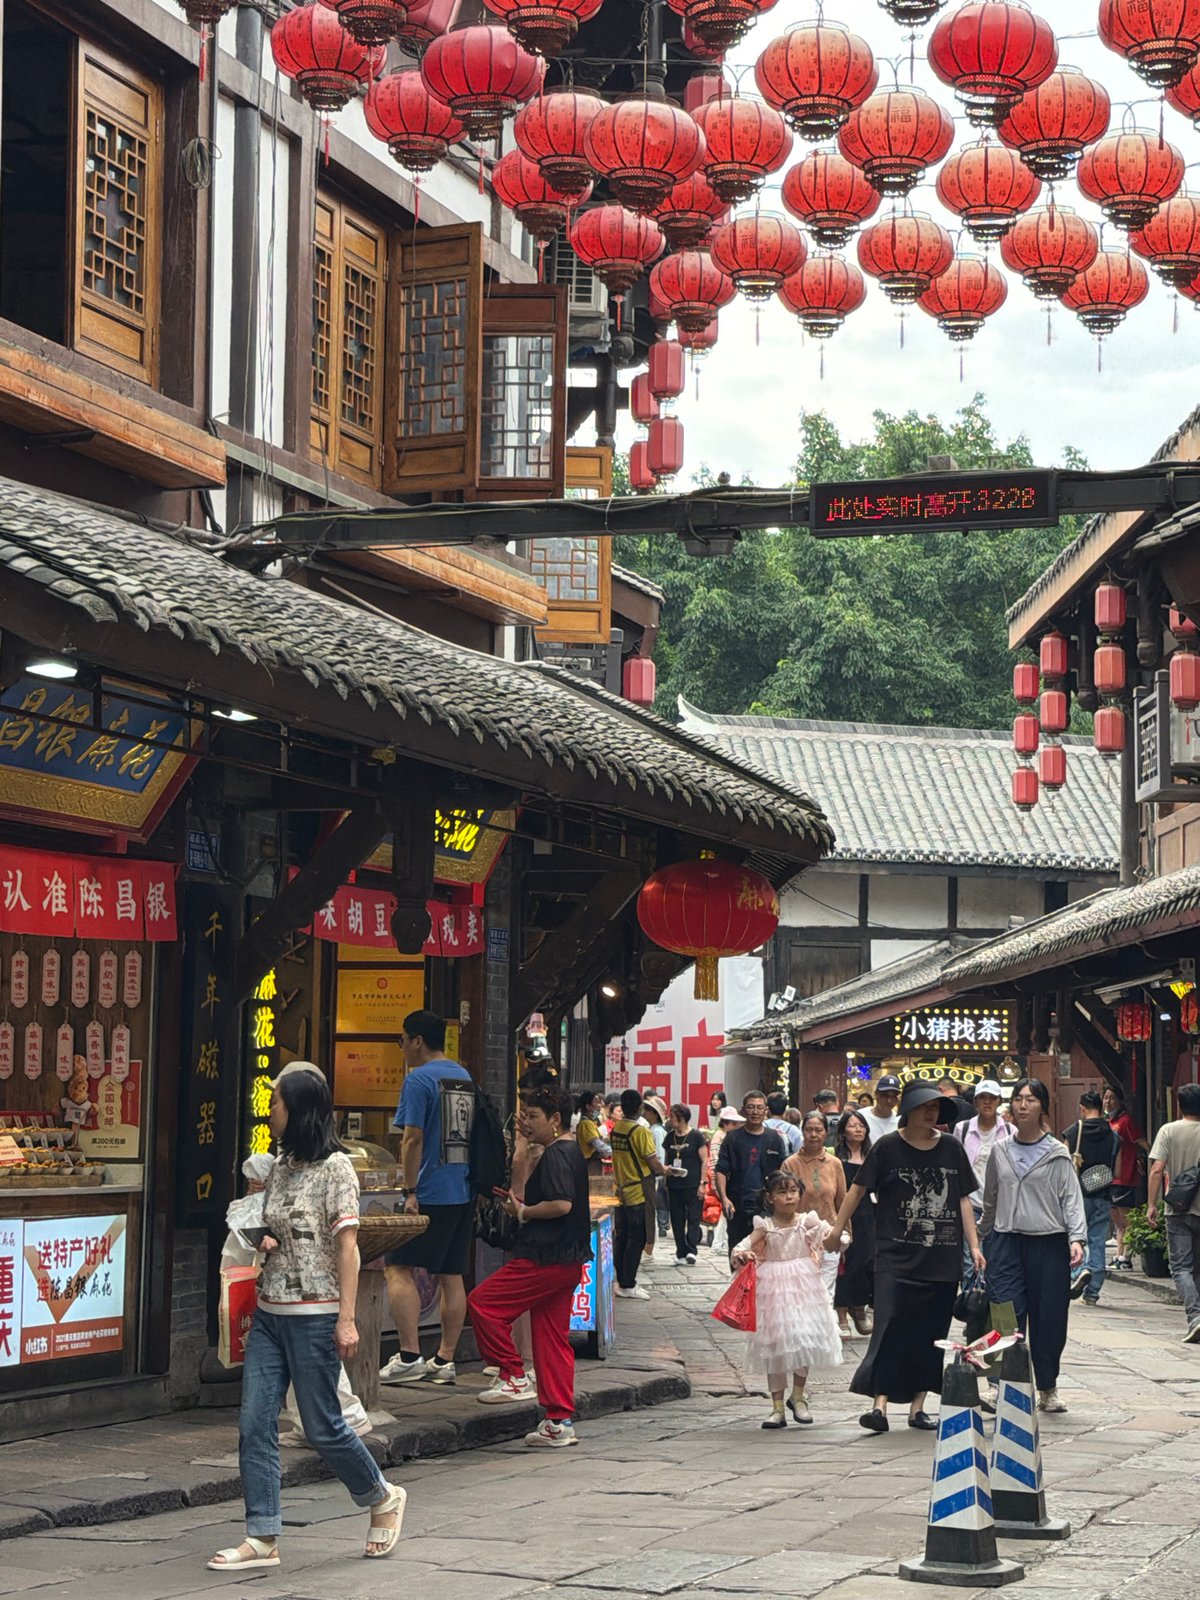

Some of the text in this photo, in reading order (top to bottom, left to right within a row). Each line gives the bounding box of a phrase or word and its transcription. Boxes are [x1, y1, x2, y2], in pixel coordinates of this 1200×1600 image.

[890, 105, 912, 123] 福
[3, 869, 173, 922] 认准陈昌银
[89, 1029, 101, 1060] 五香味
[902, 1015, 1002, 1043] 小猪找茶
[196, 911, 223, 1200] 千年磁器口
[104, 1080, 116, 1127] 全国包邮
[37, 1234, 114, 1271] 送特产好礼
[36, 1271, 113, 1303] 选陈昌银麻花
[25, 1336, 49, 1356] 小红书
